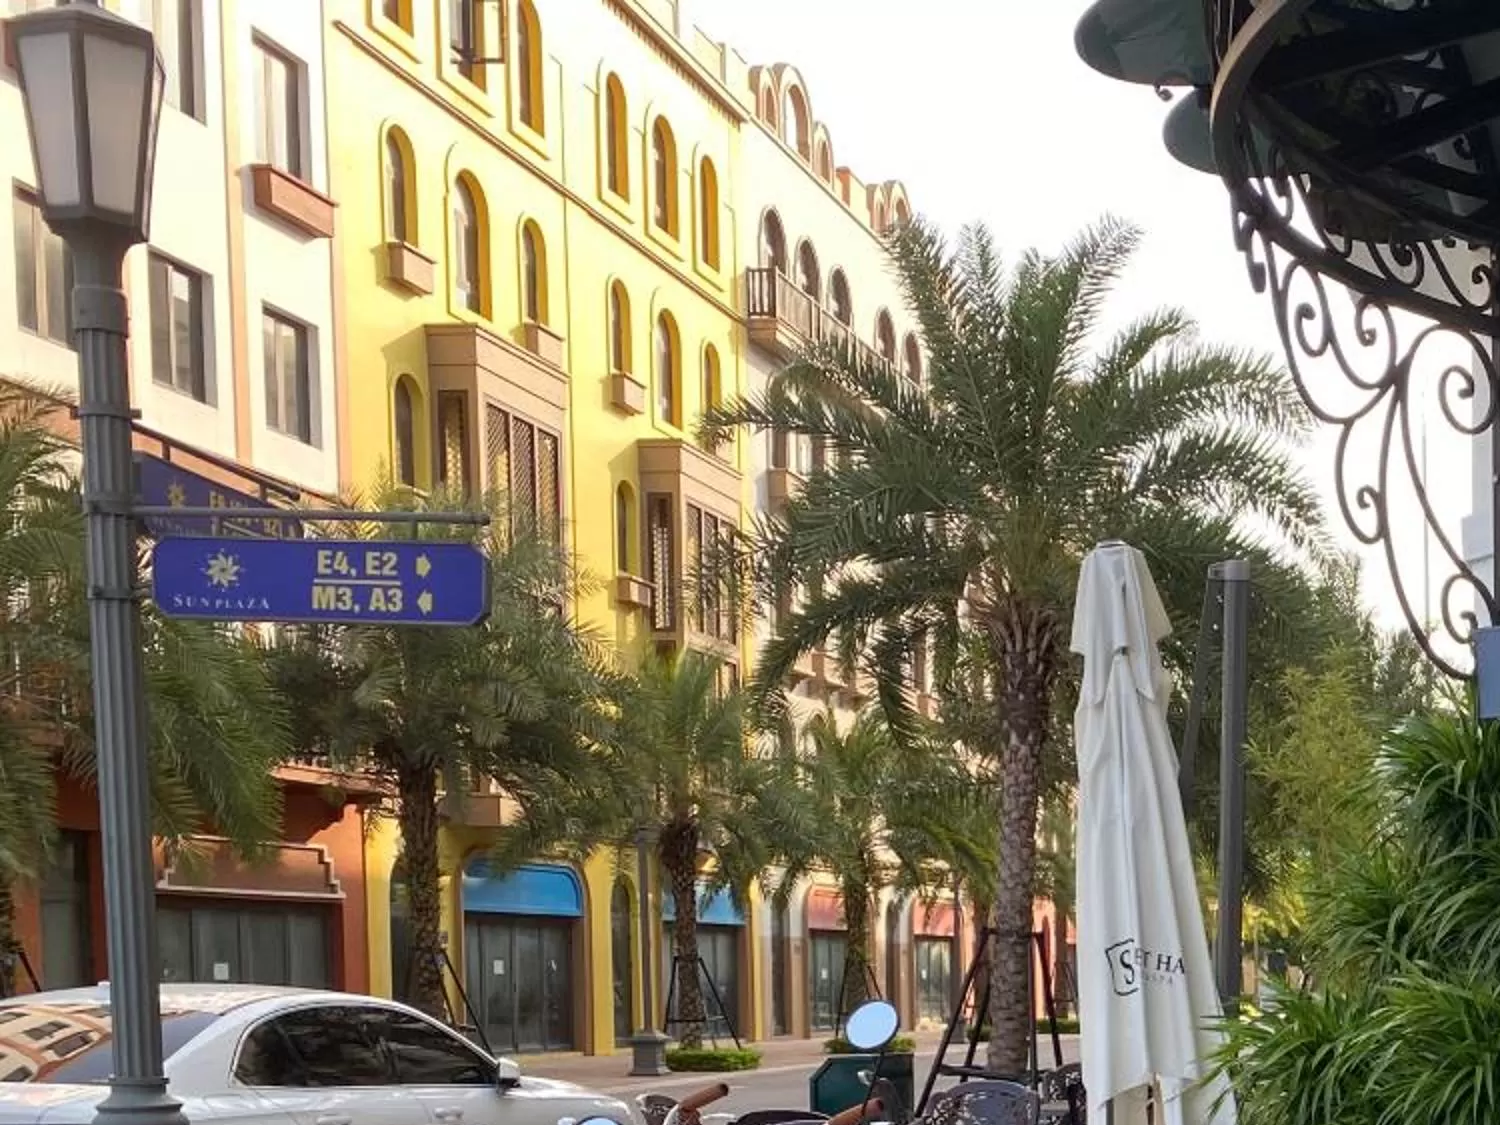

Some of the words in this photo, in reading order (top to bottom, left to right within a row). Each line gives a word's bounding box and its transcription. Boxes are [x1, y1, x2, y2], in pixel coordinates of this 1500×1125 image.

[316, 549, 358, 577] E4,
[364, 551, 399, 576] E2
[173, 595, 210, 607] SUN
[214, 597, 270, 609] PLAZA
[311, 585, 361, 614] M3,
[368, 587, 404, 612] A3
